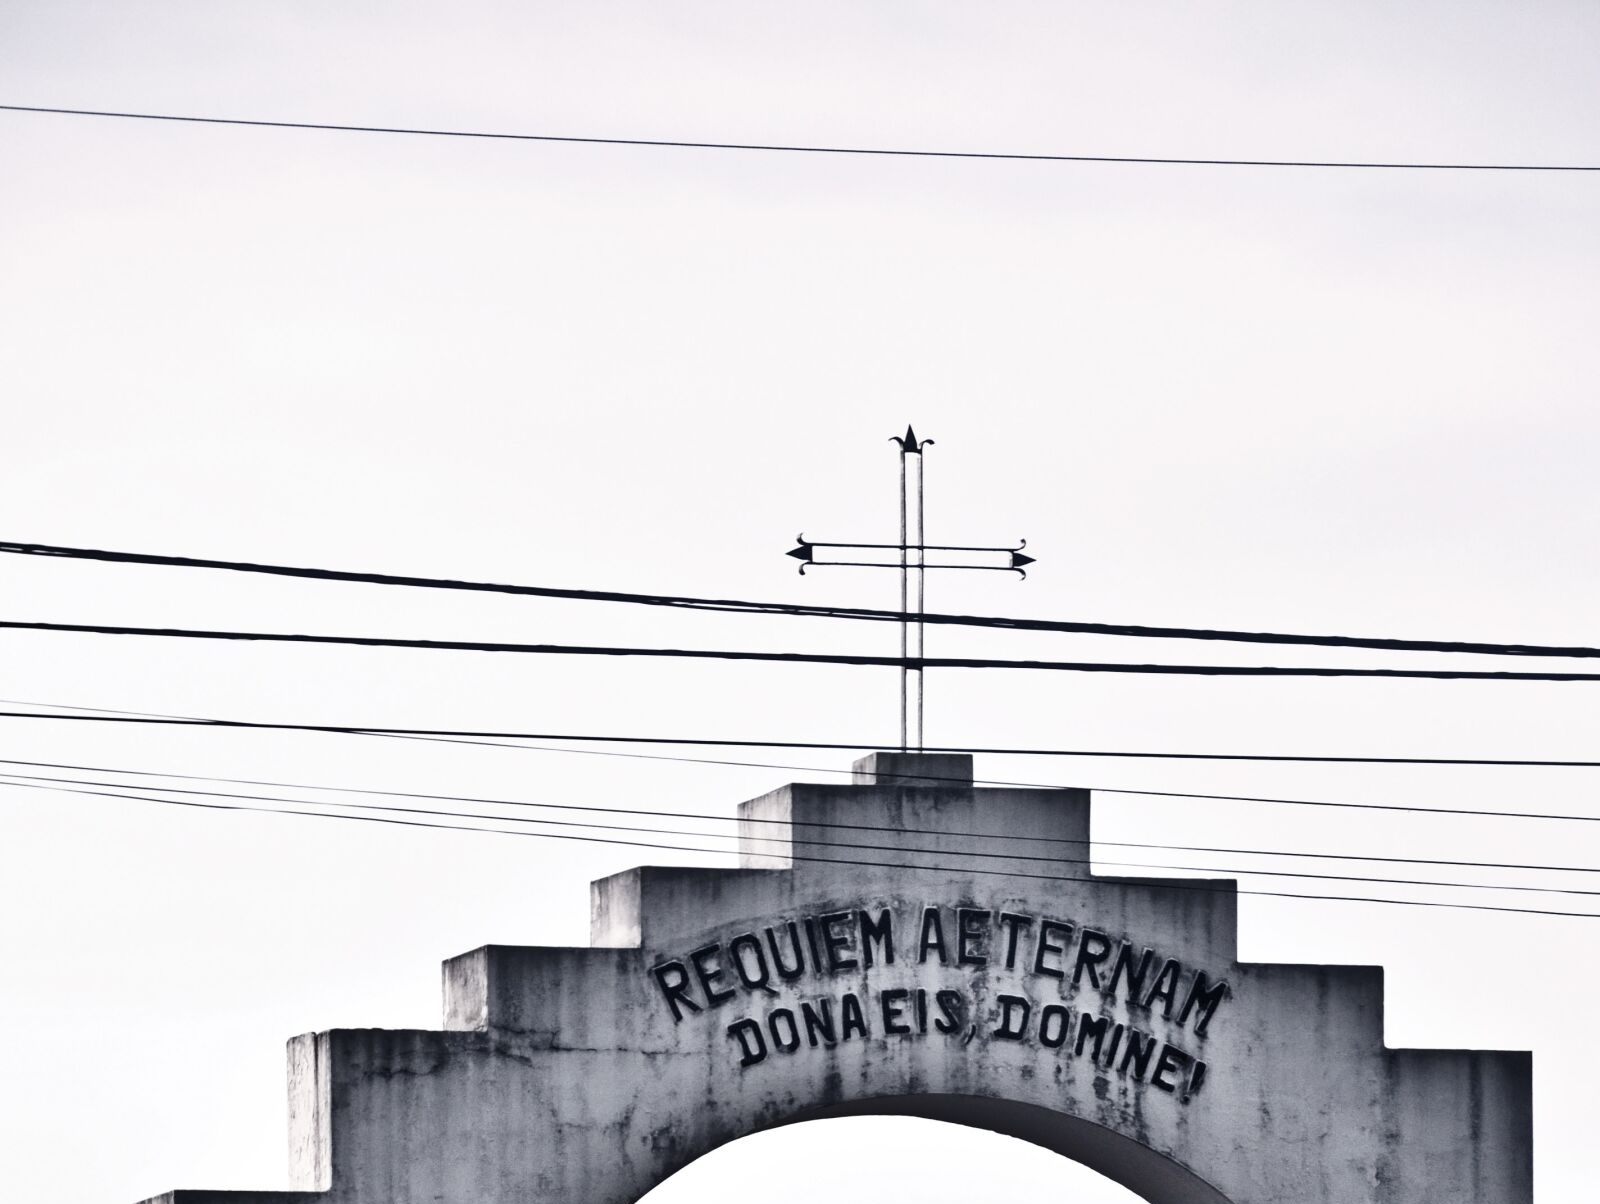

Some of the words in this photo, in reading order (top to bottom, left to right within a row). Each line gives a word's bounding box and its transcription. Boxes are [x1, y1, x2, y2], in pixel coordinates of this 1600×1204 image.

[653, 906, 895, 1023] REQUIEM
[916, 907, 1230, 1037] AETERNAM
[727, 991, 868, 1068] DONA
